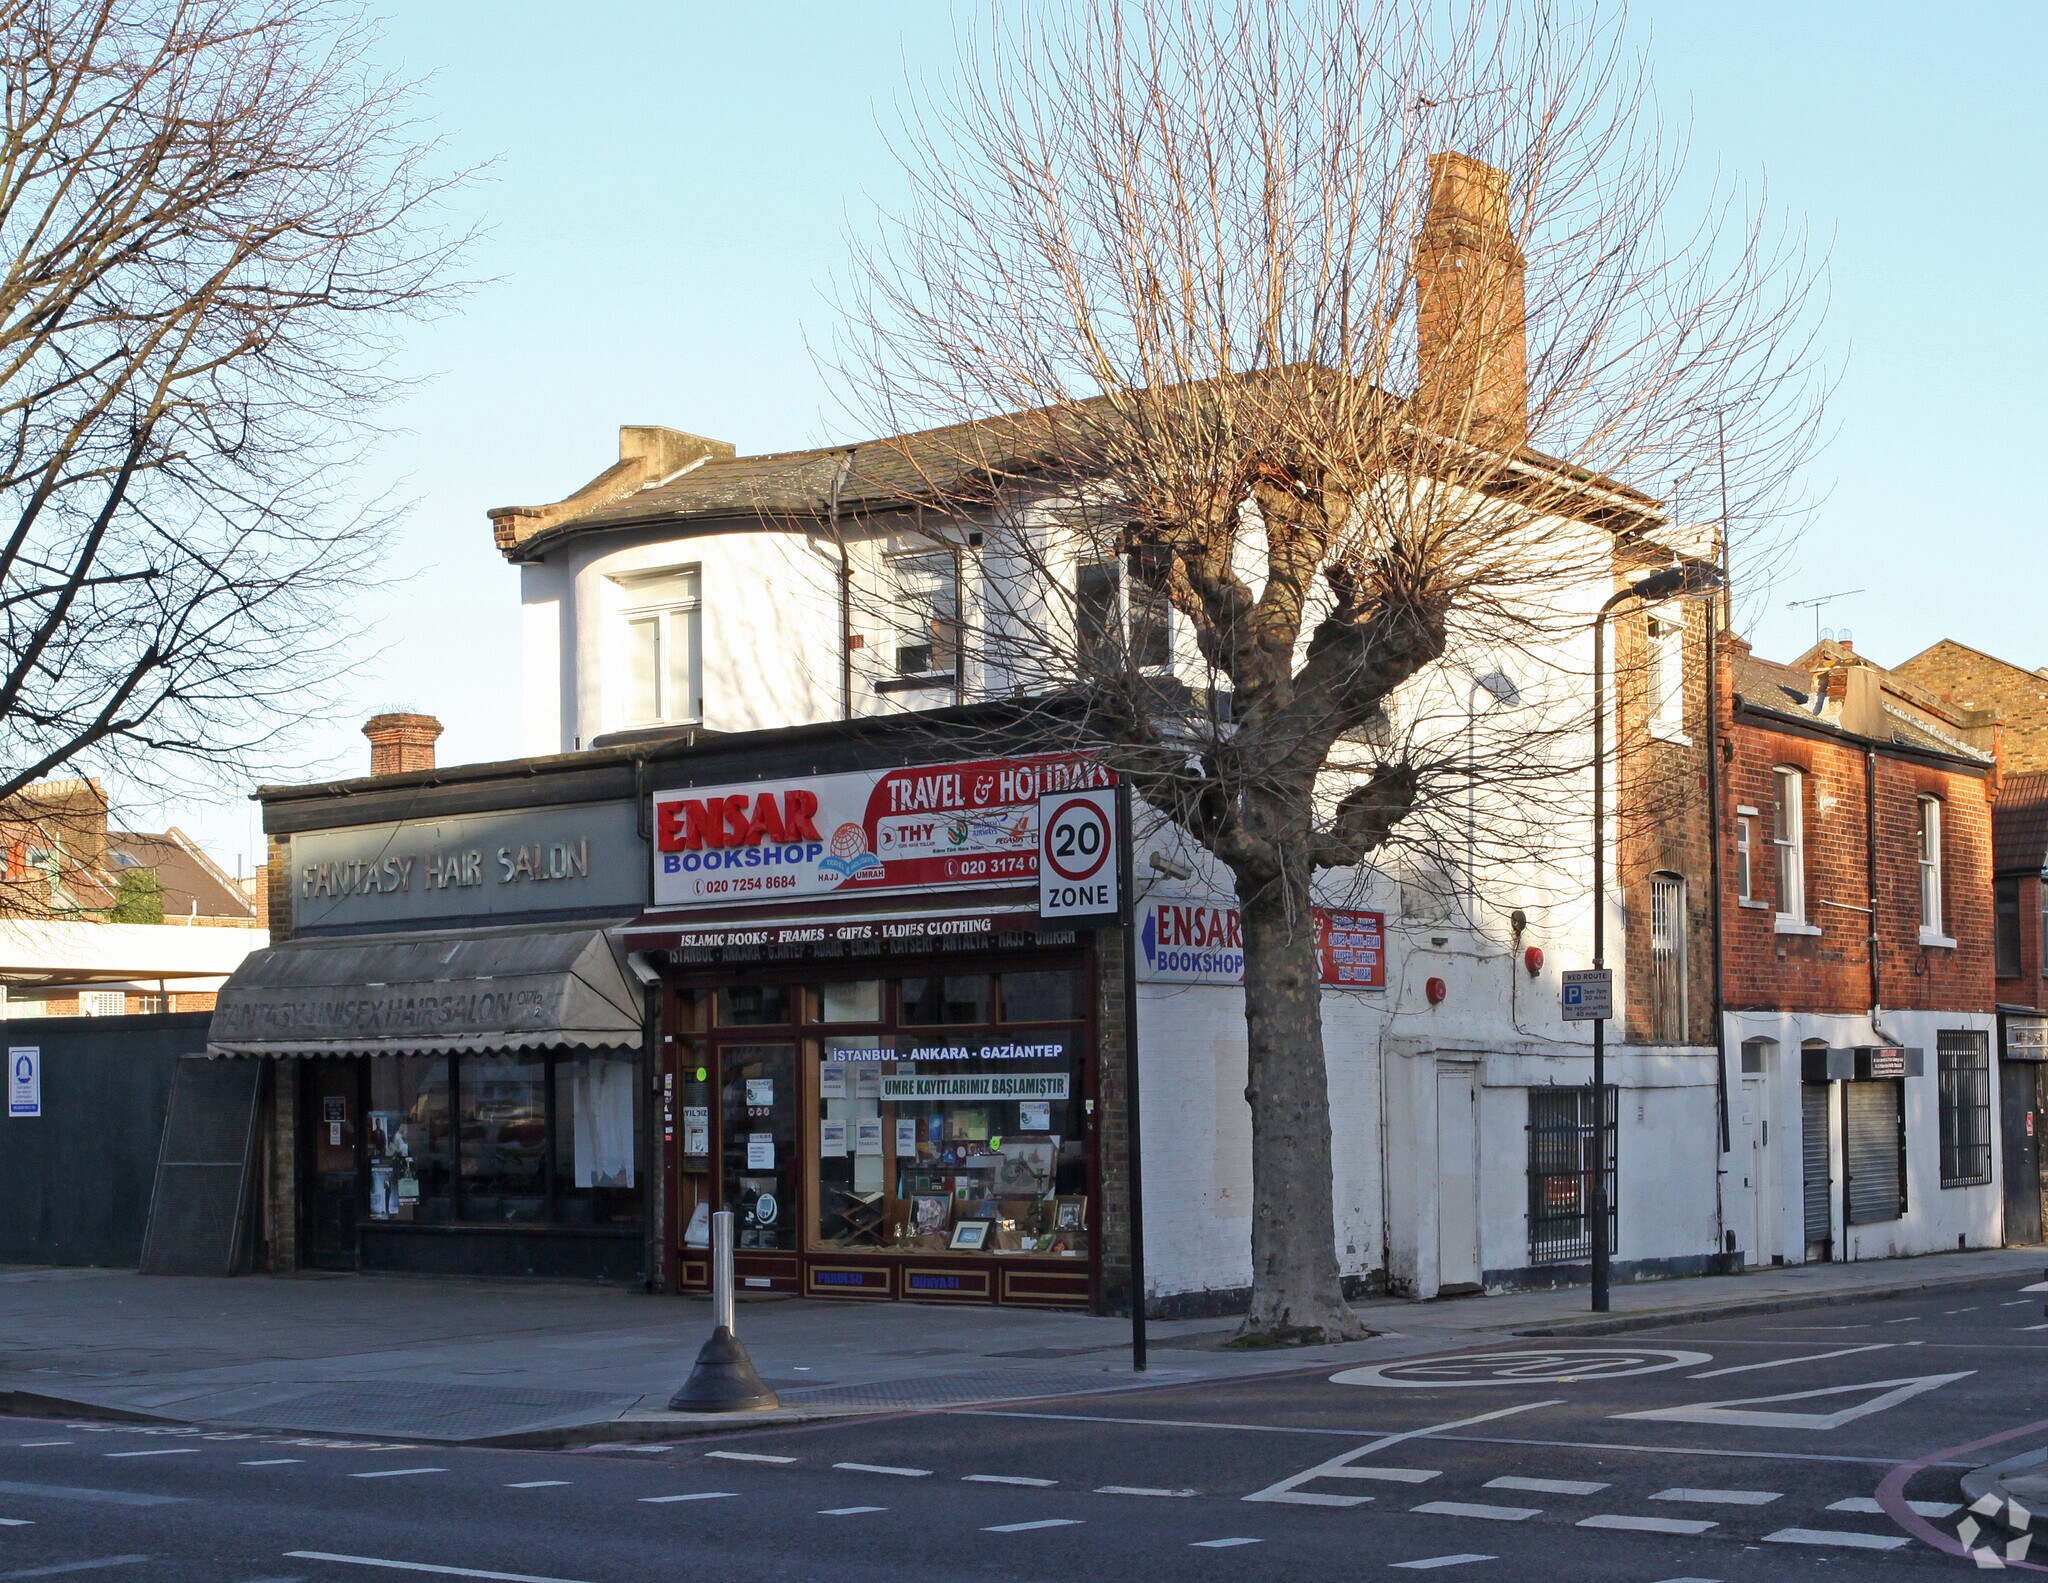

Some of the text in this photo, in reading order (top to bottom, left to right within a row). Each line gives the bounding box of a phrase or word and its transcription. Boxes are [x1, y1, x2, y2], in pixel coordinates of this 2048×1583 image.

[887, 774, 965, 812] TRAVEL
[973, 776, 995, 804] &
[657, 790, 824, 852] ENSAR
[898, 823, 935, 843] THY
[995, 836, 1024, 845] PEGASUS
[1056, 821, 1100, 857] 20
[301, 836, 588, 899] FANTASY HAIR SALON
[664, 843, 824, 874] BOOKSHOP
[961, 860, 986, 875] 020
[990, 858, 1024, 873] 3174
[706, 875, 796, 893] 020 7254 8684
[818, 873, 839, 882] HAJJ
[856, 868, 884, 880] UMRAH
[1048, 885, 1110, 908] ZONE
[681, 934, 725, 947] ISLAMIC
[727, 932, 768, 946] BOOKS
[778, 928, 825, 943] FRAMES
[836, 926, 872, 940] GIFTS
[882, 923, 925, 938] LADIES
[926, 918, 992, 936] CLOTHING
[1157, 905, 1243, 948] ENSAR
[1158, 951, 1244, 974] BOOKSHOP
[1584, 972, 1607, 980] ROUTE
[1568, 988, 1580, 1002] P
[220, 1003, 306, 1031] FANTASY
[307, 999, 381, 1029] UNISEX
[386, 997, 438, 1027] HAIR
[438, 991, 513, 1023] SALON
[833, 1048, 898, 1062] İSTANBUL
[910, 1046, 970, 1060] ANKARA
[980, 1044, 1063, 1059] GAZİANTEP
[884, 1078, 1064, 1096] UMRE KAYITLARIMIZ BAŞLAMIŞTIR
